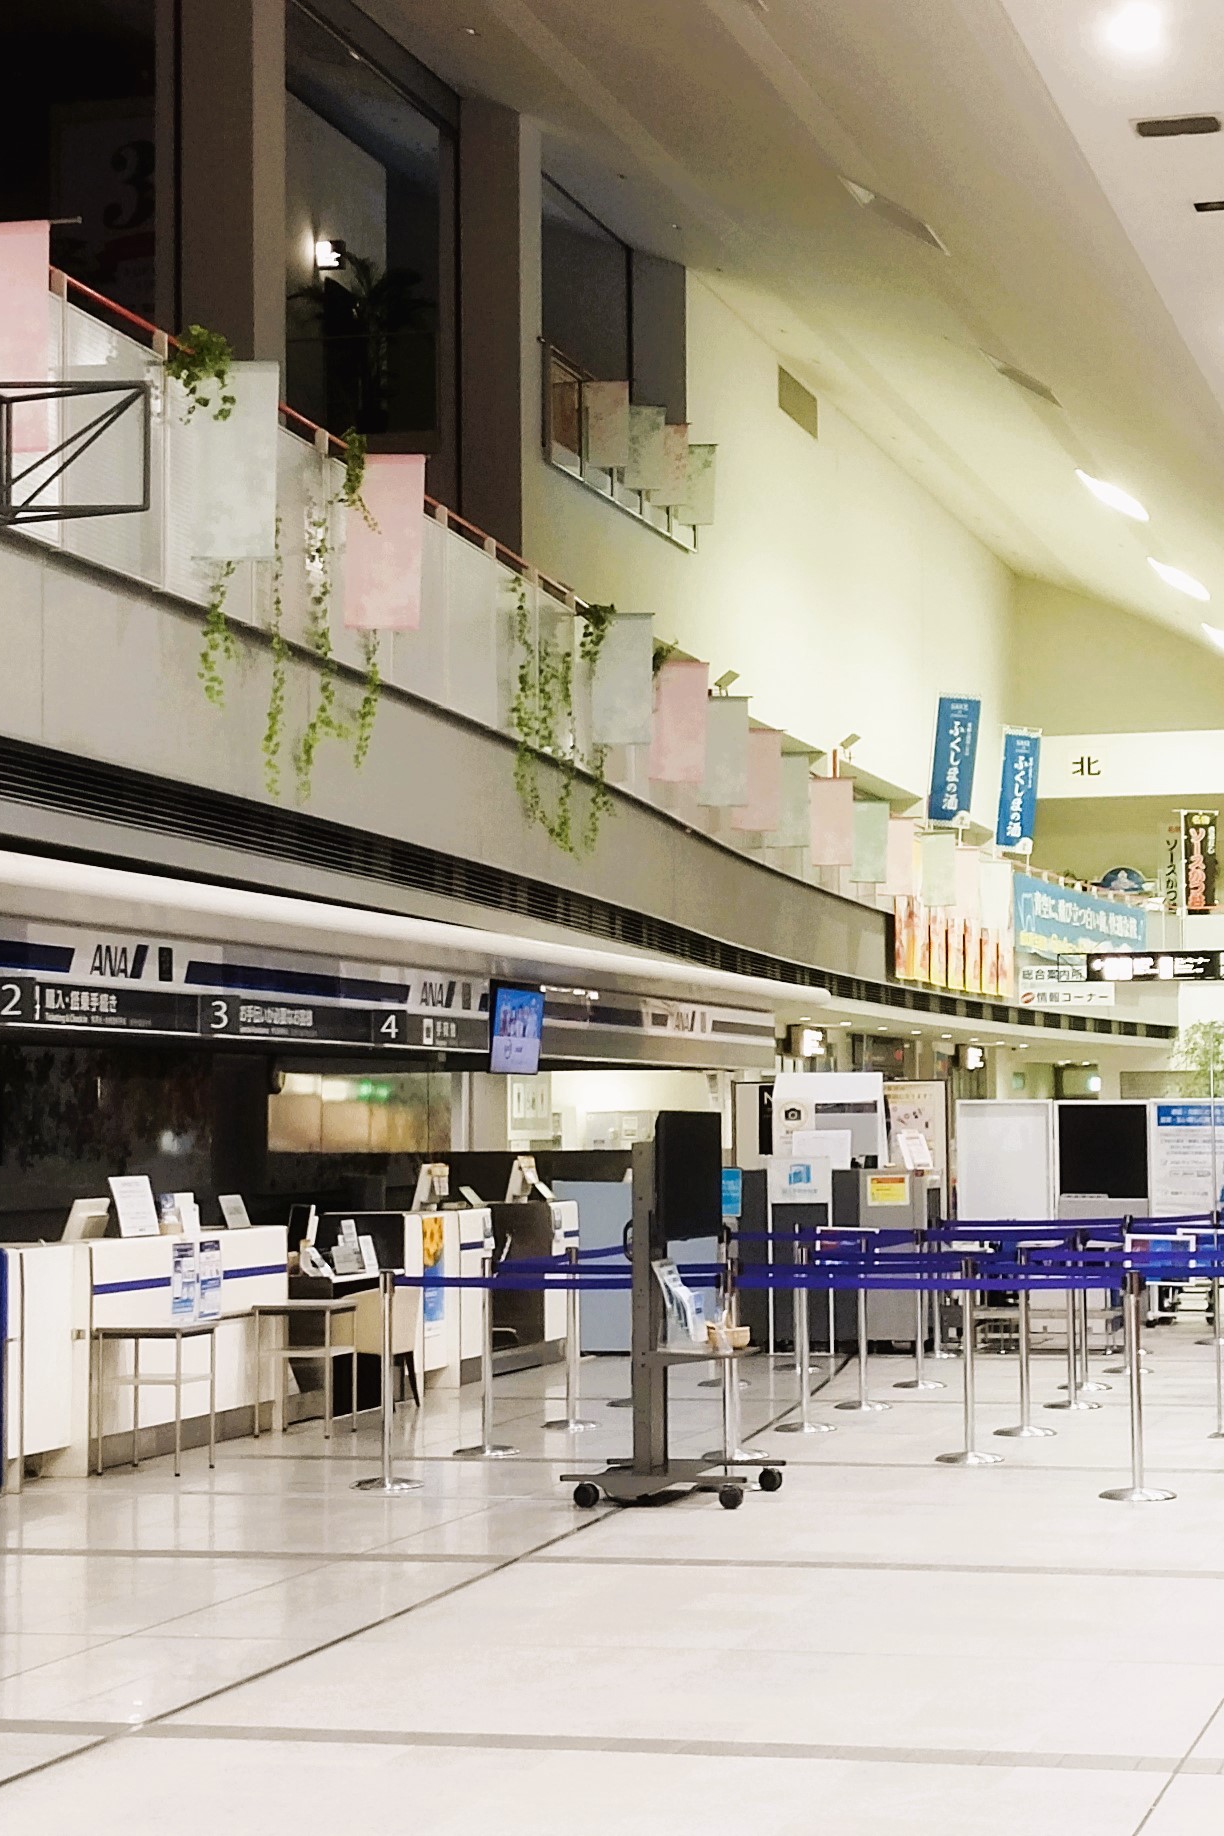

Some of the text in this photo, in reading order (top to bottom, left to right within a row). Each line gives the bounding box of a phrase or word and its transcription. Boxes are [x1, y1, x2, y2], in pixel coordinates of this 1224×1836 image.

[941, 720, 966, 812] ふくしまの酒
[1072, 755, 1101, 776] 北
[1007, 755, 1032, 838] ふくしまの酒
[89, 944, 128, 979] ANA
[0, 984, 22, 1017] 2
[420, 980, 444, 1007] ANA
[1037, 991, 1109, 1004] 情報コーナー
[210, 1000, 229, 1029] 3
[380, 1014, 399, 1039] 4
